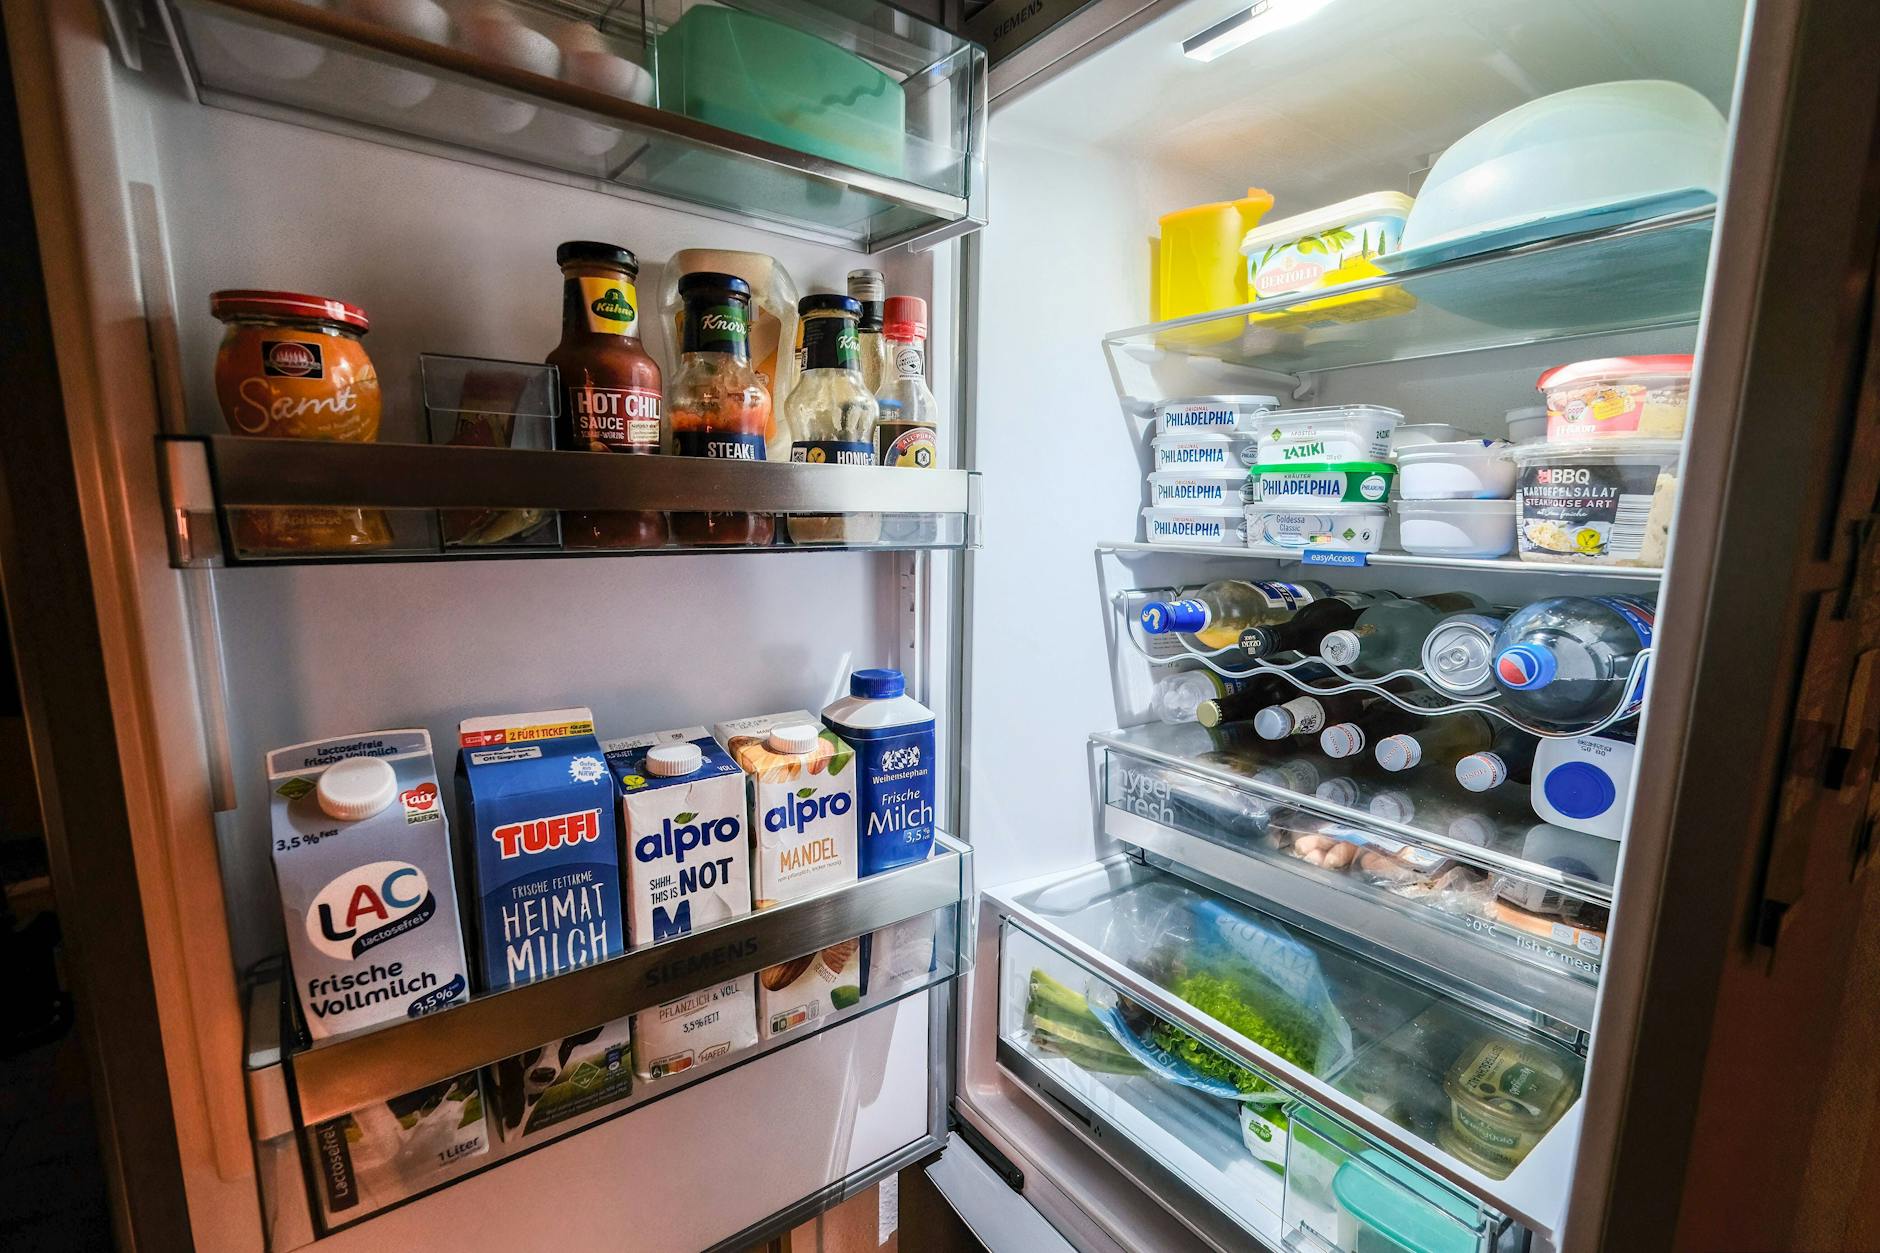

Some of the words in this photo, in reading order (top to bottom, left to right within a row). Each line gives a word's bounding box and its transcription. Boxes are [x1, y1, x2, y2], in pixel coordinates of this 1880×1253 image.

[993, 0, 1043, 41] SIEMENS
[1260, 266, 1319, 290] BERTOLLI
[596, 302, 634, 318] Kühne
[702, 314, 747, 335] Knorr
[838, 336, 860, 351] Kno
[234, 378, 358, 433] Samt
[577, 392, 622, 415] HOT
[579, 416, 624, 431] SAUCE
[1166, 410, 1234, 428] PHILADELPHIA
[708, 442, 750, 460] STEAK
[1160, 448, 1224, 464] PHILADELPHIA
[1283, 442, 1325, 460] ZAZIKI
[1551, 468, 1590, 485] BBQ
[1158, 484, 1222, 500] PHILADELPHIA
[1263, 479, 1341, 497] PHILADELPHIA
[1525, 498, 1582, 508] STEAKHOUSE
[1586, 499, 1613, 508] ART
[1154, 520, 1220, 536] PHILADELPHIA
[1311, 553, 1356, 564] easyAccess
[510, 732, 517, 741] 2
[517, 729, 535, 740] FÜR
[540, 726, 568, 738] TICKET
[317, 740, 383, 756] Lactosefreie
[304, 755, 344, 767] frische
[717, 764, 736, 772] VOLL
[872, 768, 928, 785] Weihenstephan
[881, 788, 921, 806] Frische
[408, 813, 439, 824] BAUERN
[764, 791, 852, 834] alpro
[867, 800, 933, 836] Milch
[1119, 796, 1175, 826] resh
[276, 837, 301, 851] 3,5
[303, 832, 319, 844] %
[494, 810, 600, 858] TUFFI
[635, 815, 741, 864] alpro
[906, 829, 922, 843] 3,5
[780, 837, 839, 873] MANDEL
[512, 877, 549, 899] FRISCHE
[552, 870, 593, 888] FETTARME
[679, 857, 734, 896] NOT
[318, 868, 421, 942] LAC
[651, 889, 669, 905] THIS
[670, 887, 678, 899] IS
[502, 883, 604, 942] HEIMAT
[506, 920, 609, 984] MILCH
[1516, 934, 1541, 954] fish
[1560, 951, 1601, 975] meat
[645, 937, 759, 987] SIEMENS
[308, 961, 403, 998] frische
[310, 972, 437, 1019] Vollmilch
[659, 993, 710, 1020] PFLANZLICH
[720, 983, 740, 998] VOLL
[700, 1046, 727, 1063] HAFER
[446, 1135, 480, 1157] Liter
